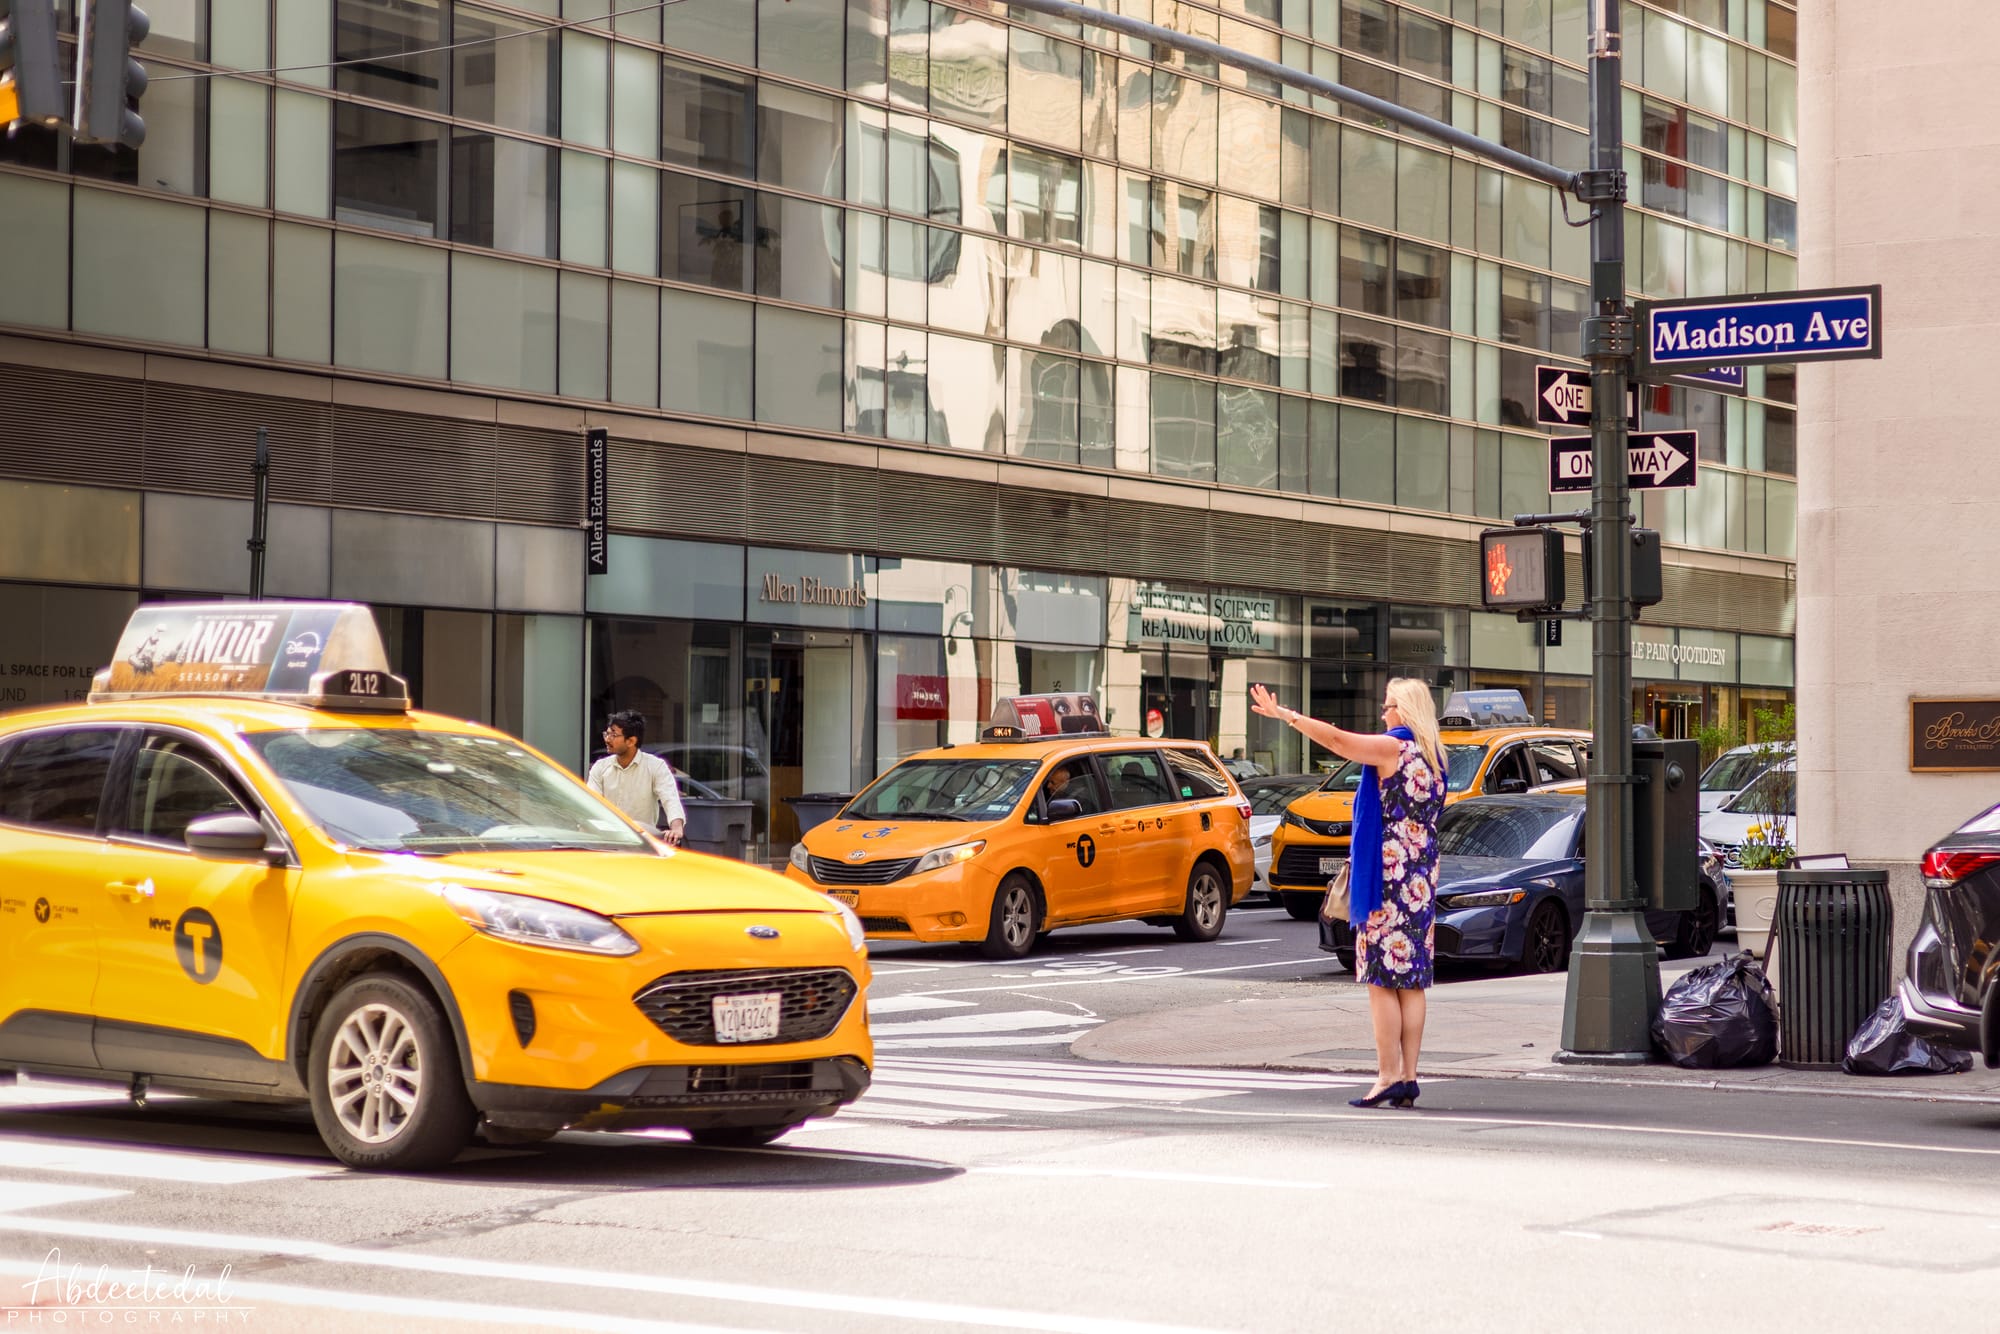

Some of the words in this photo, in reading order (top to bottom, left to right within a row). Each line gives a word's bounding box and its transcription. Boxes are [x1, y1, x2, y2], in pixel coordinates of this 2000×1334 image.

[1655, 317, 1795, 352] Madison
[1804, 311, 1867, 343] Ave
[1554, 386, 1585, 410] ONE
[1571, 454, 1592, 474] ON
[1630, 450, 1674, 473] WAY
[591, 438, 603, 517] Edmonds
[591, 520, 603, 565] Allen
[760, 573, 797, 603] Allen
[802, 576, 868, 608] Edmonds
[1214, 598, 1271, 621] SCIENCE
[1142, 616, 1206, 641] READING
[1214, 623, 1260, 645] ROOM
[1631, 641, 1644, 659] LE
[1646, 643, 1670, 661] PAIN
[1671, 645, 1726, 666] QUOTIDIEN
[11, 664, 49, 677] SPACE
[53, 665, 76, 678] FOR
[80, 667, 98, 678] LE
[350, 673, 379, 694] 2L12
